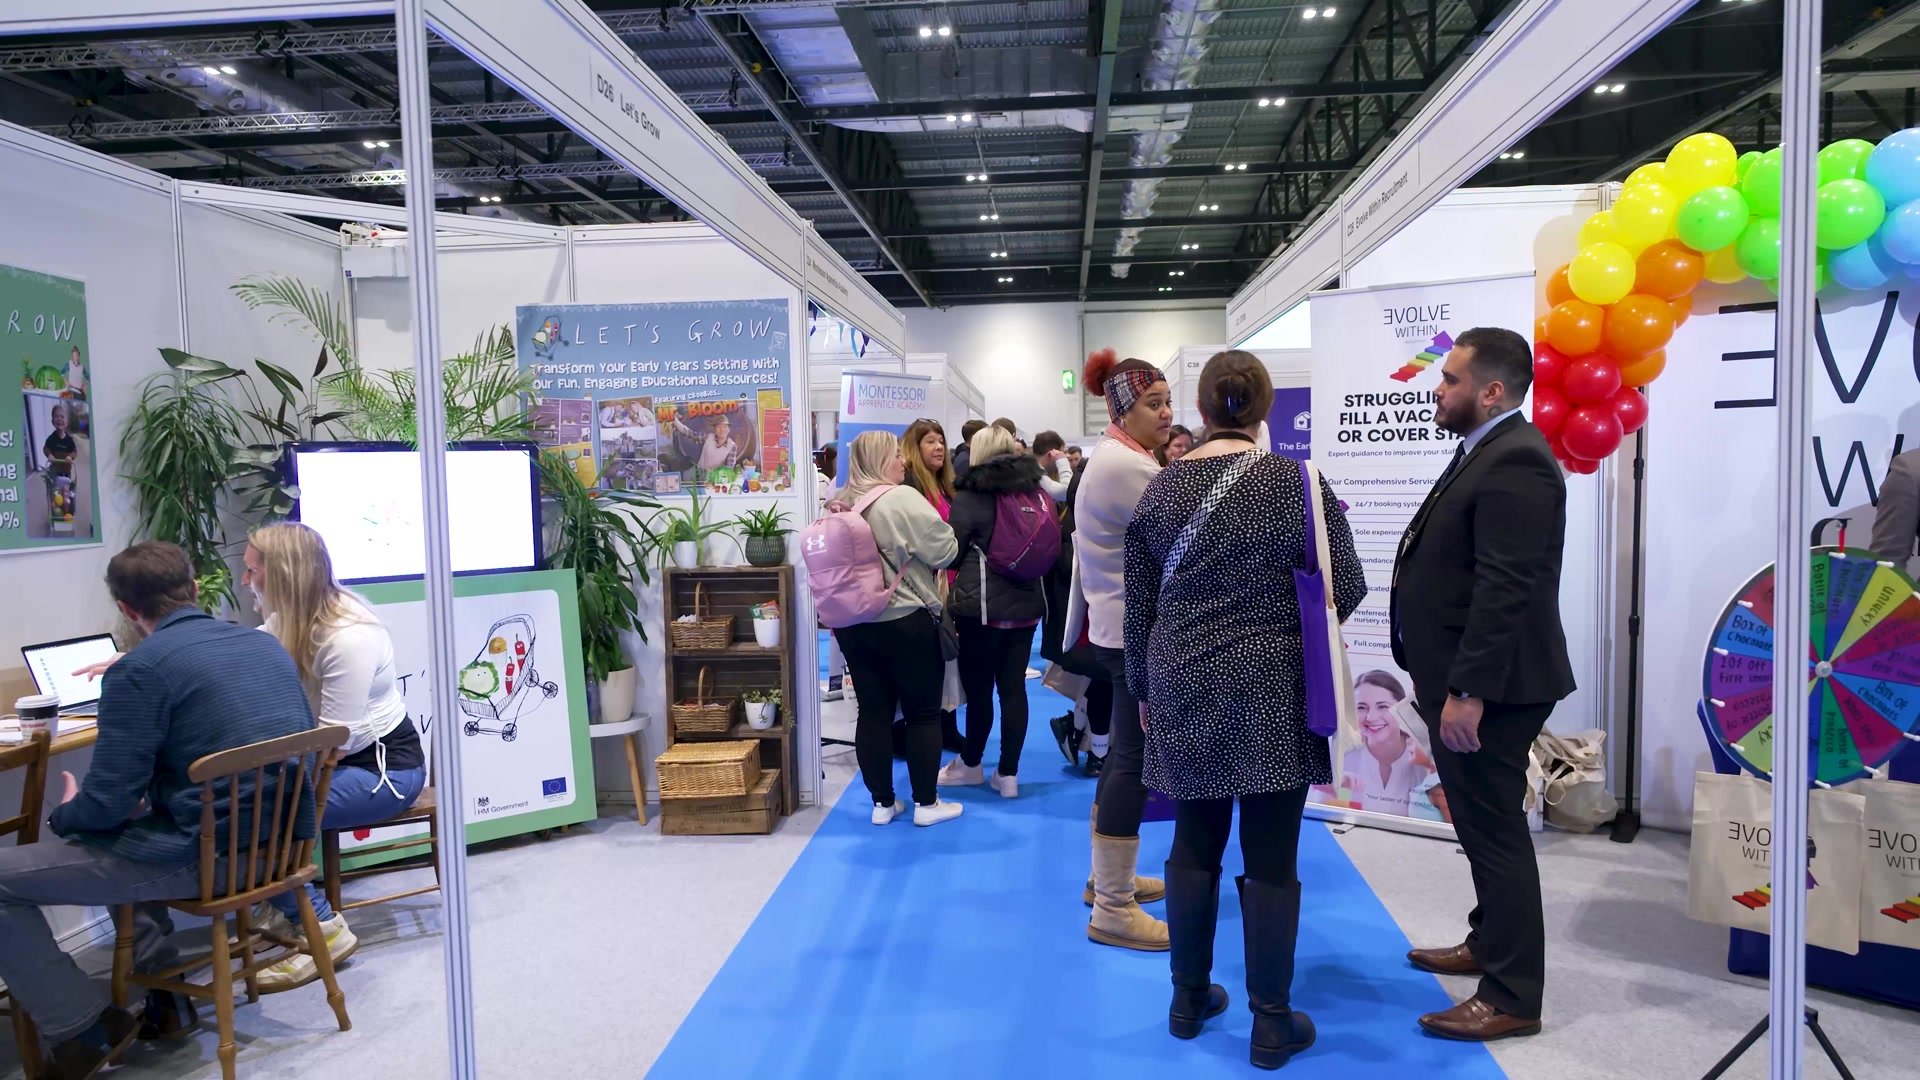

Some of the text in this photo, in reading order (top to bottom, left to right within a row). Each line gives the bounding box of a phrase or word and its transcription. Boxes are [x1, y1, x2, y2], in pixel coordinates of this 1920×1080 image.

[597, 73, 660, 140] D26 Let's Grow
[575, 317, 772, 346] LET'S GROW
[1395, 324, 1438, 338] WITHIN
[600, 361, 625, 374] Your
[630, 361, 660, 375] Early
[664, 360, 699, 372] Years
[703, 358, 749, 372] Setting
[584, 377, 637, 391] Engaging
[641, 373, 709, 388] Educational
[711, 372, 778, 386] Resources!
[858, 384, 926, 401] MONTESSORI
[858, 399, 896, 409] APPRENTICE
[1340, 409, 1437, 425] FILL A VAC
[1338, 429, 1363, 443] OR
[1368, 428, 1430, 442] COVER
[1328, 450, 1350, 458] Expert
[1351, 450, 1383, 458] guidance
[1328, 478, 1342, 486] Our
[1343, 478, 1407, 487] Comprehensive
[1374, 501, 1402, 509] booking
[1354, 609, 1387, 617] Preferred
[478, 801, 529, 816] HM Government
